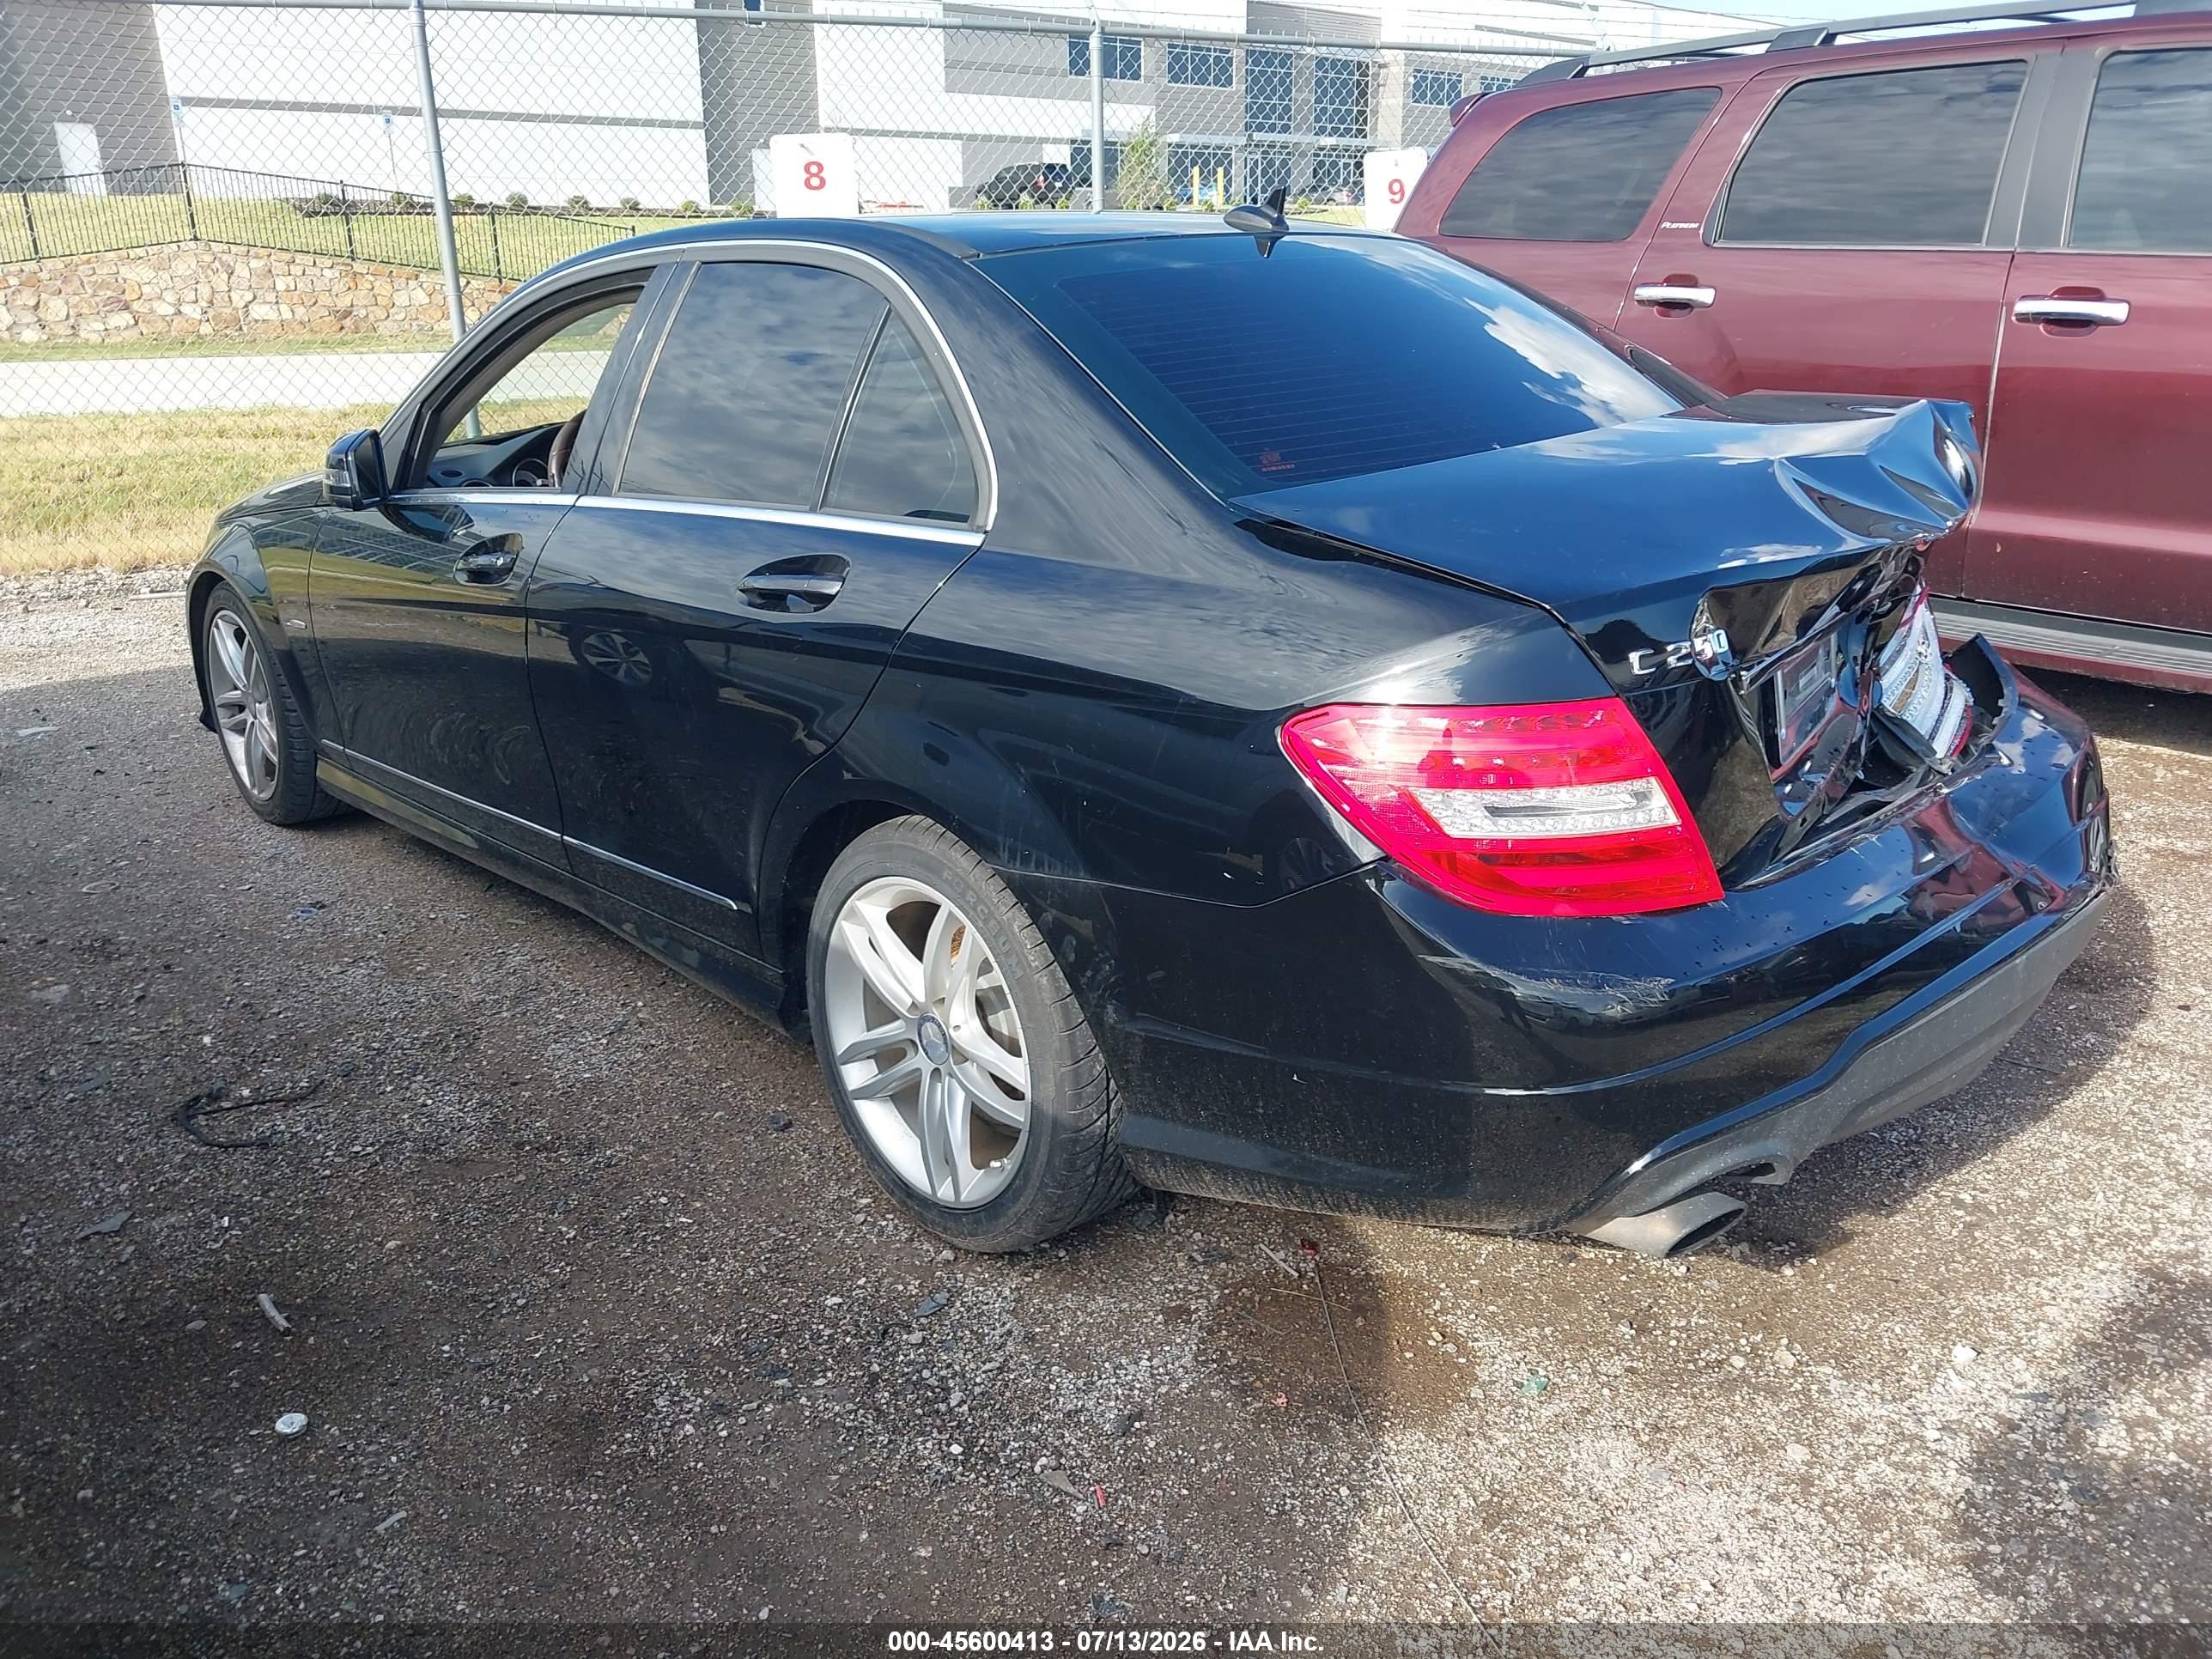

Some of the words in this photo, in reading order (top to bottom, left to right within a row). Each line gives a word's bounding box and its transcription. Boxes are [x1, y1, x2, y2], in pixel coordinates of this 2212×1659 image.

[804, 161, 826, 191] 8
[1388, 178, 1405, 204] 9
[1628, 647, 1656, 675] C
[1666, 629, 1729, 669] 250
